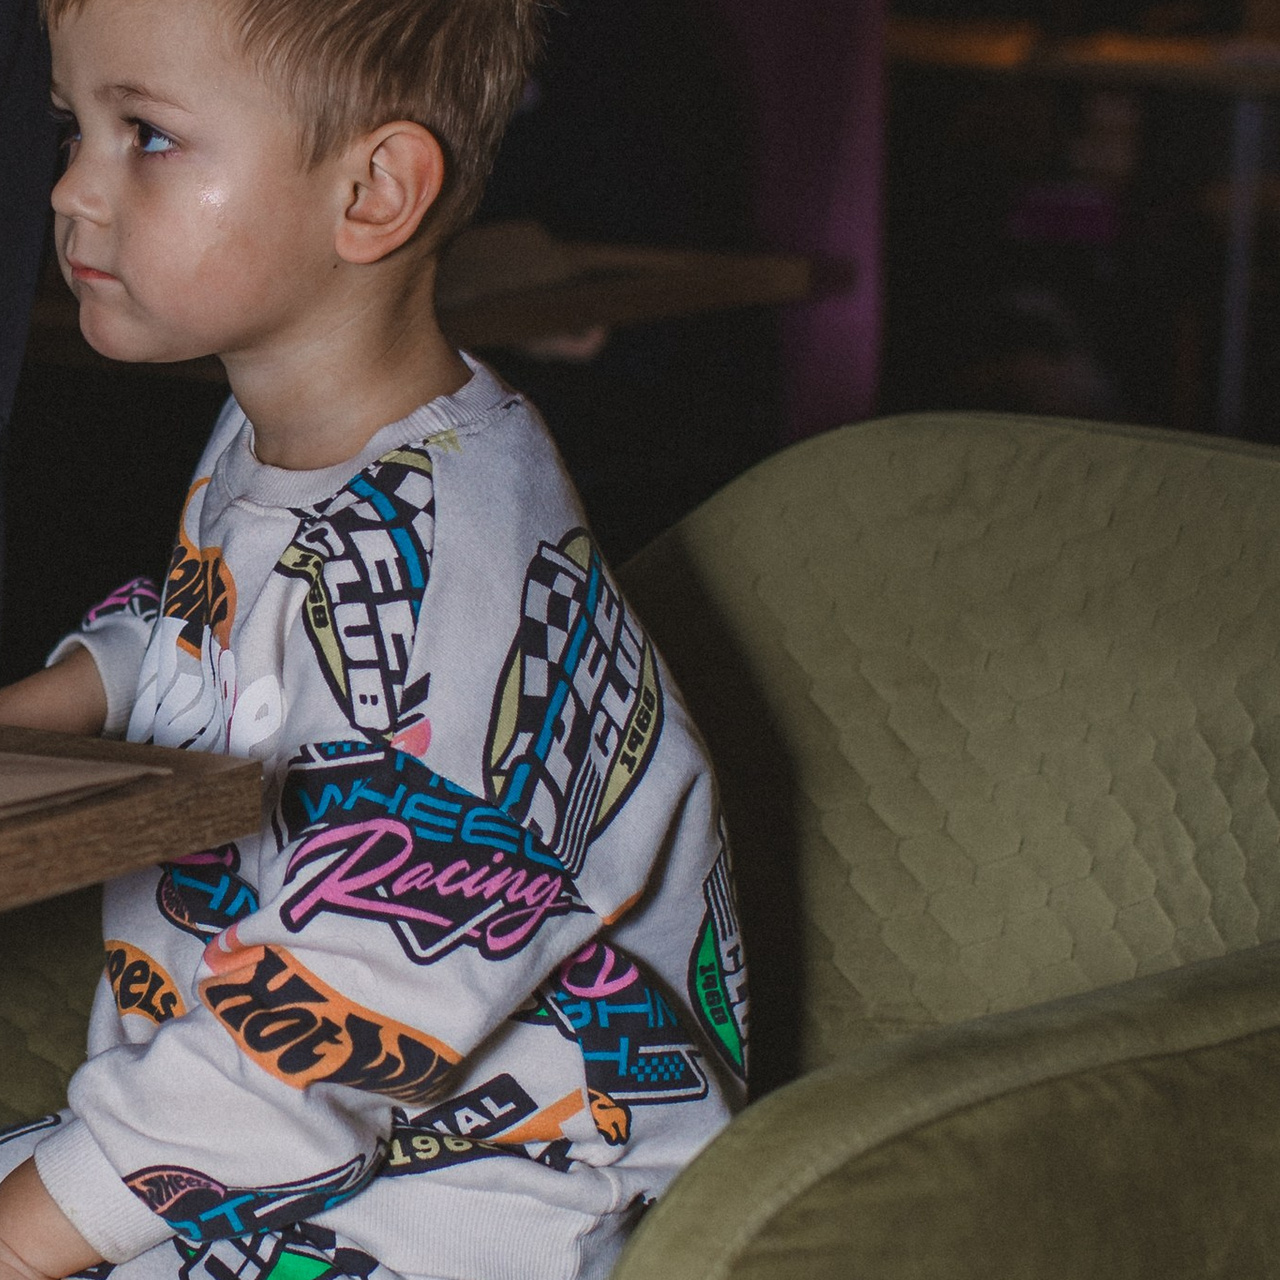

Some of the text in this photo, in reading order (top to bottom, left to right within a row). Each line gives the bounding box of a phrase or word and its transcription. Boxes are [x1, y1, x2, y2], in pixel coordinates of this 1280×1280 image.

[296, 519, 392, 731] CLUB
[619, 687, 657, 775] 1968
[300, 777, 567, 872] WHEEL
[286, 817, 569, 952] Racing
[388, 1134, 498, 1167] 196
